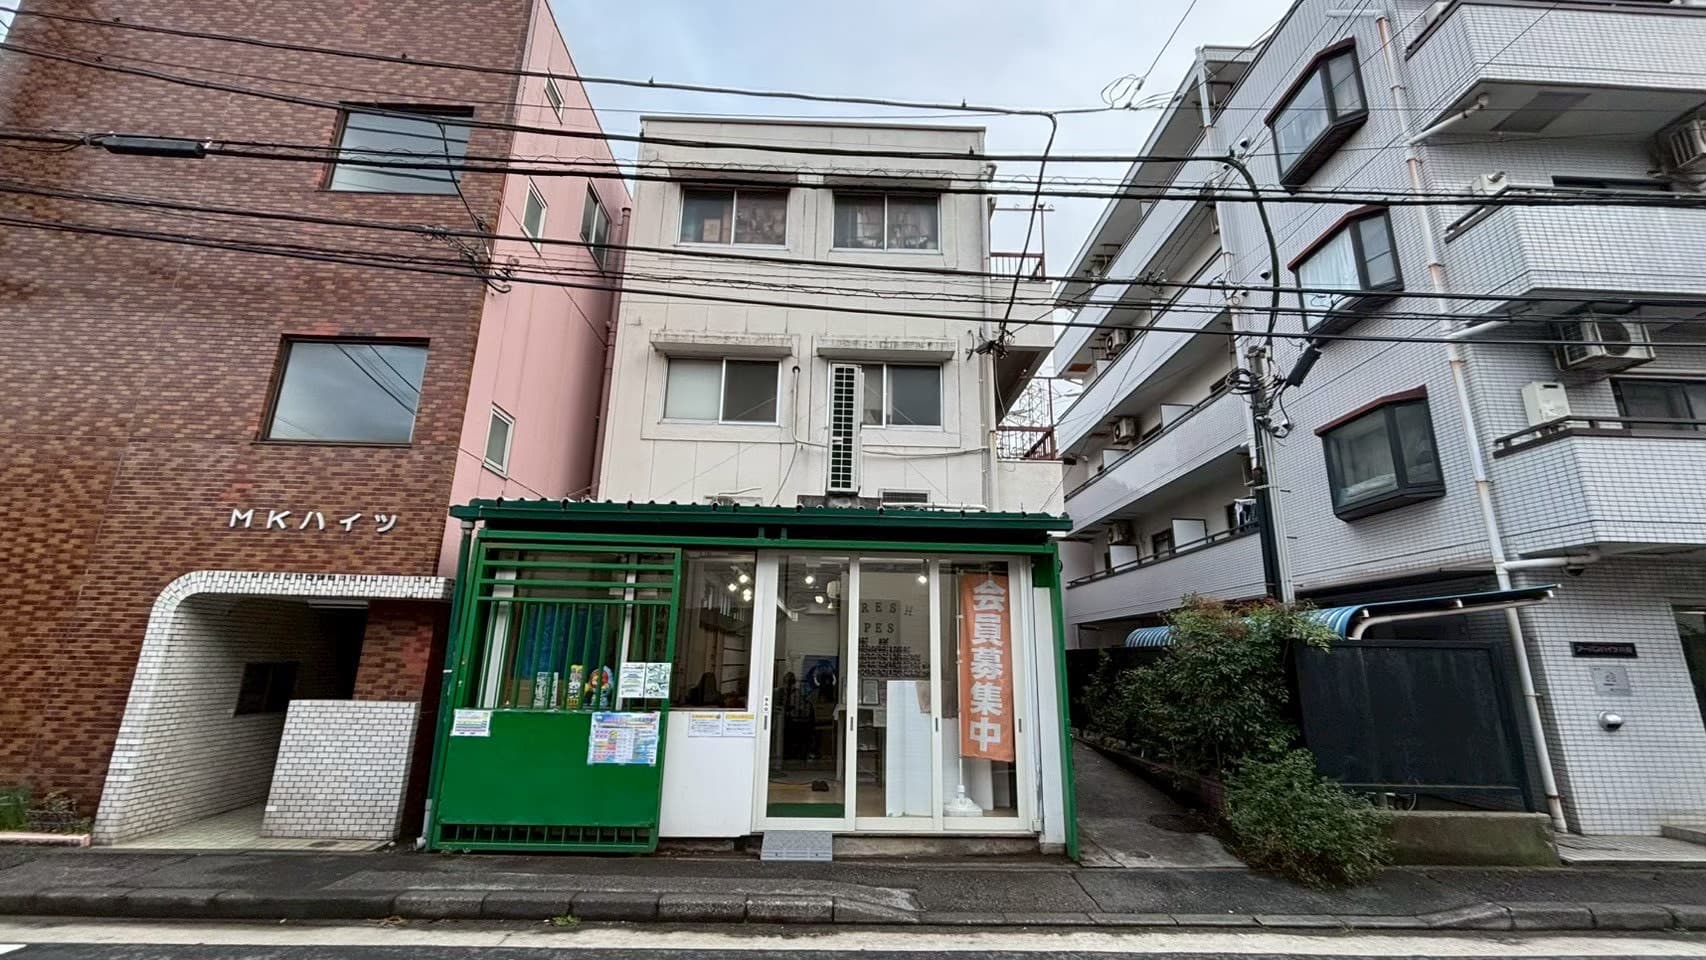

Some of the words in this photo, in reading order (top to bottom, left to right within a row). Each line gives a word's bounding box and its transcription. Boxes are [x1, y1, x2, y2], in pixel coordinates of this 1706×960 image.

[861, 601, 914, 617] RESH
[863, 622, 895, 634] PES
[969, 579, 1006, 752] 会員募集中
